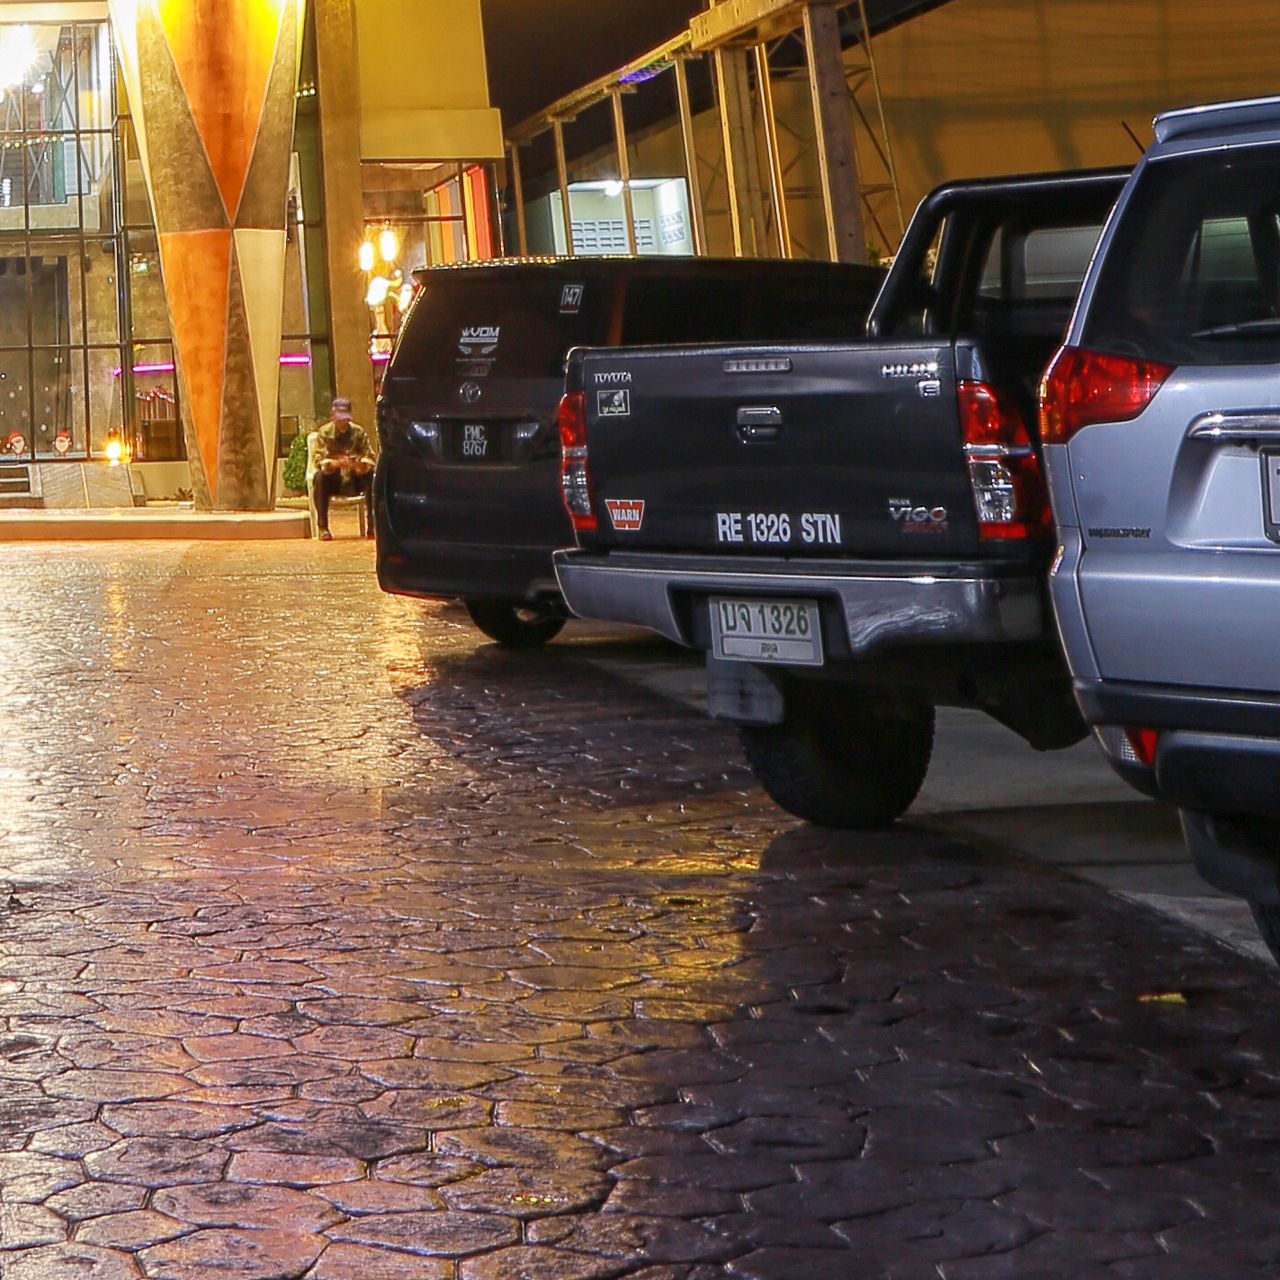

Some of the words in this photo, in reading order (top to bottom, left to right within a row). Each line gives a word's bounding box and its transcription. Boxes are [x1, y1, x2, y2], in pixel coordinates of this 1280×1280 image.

[594, 371, 632, 383] TOYOTA
[464, 425, 485, 440] PMC
[463, 440, 487, 455] 8767
[612, 508, 640, 521] WARN
[717, 512, 743, 542] RE
[747, 513, 791, 542] 1326
[801, 513, 841, 544] STN
[758, 604, 809, 636] 1326
